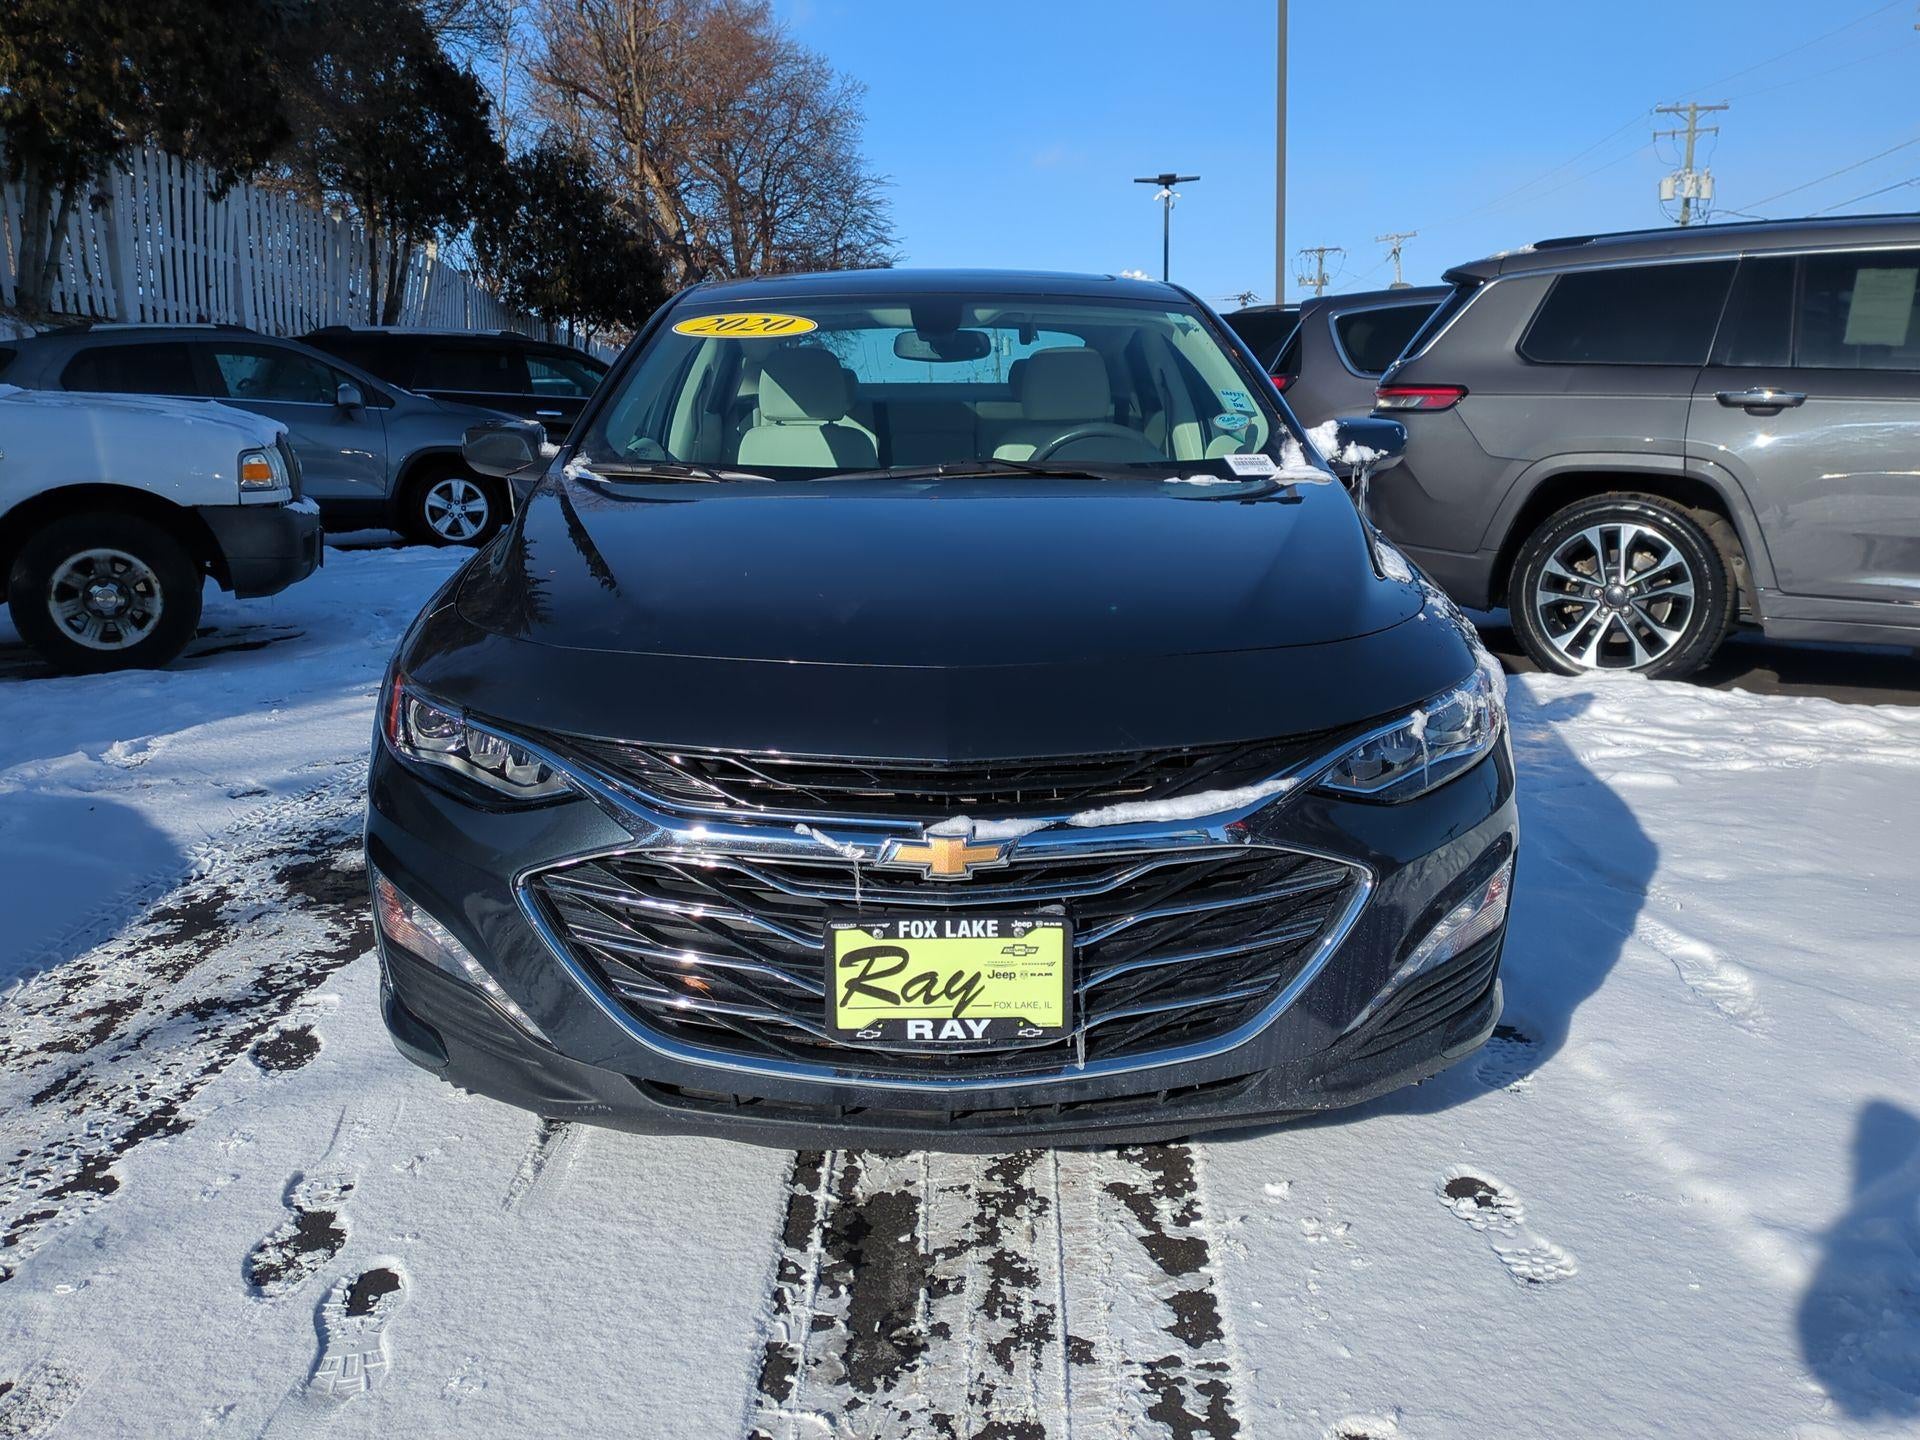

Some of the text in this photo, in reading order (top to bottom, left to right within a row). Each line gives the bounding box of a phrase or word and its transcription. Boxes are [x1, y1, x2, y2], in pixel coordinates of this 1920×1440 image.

[689, 318, 796, 331] 2020
[898, 920, 999, 939] FOX LAKE
[1011, 920, 1032, 928] Jeep
[839, 945, 986, 1018] Ray
[987, 969, 1016, 981] Jeep
[993, 1001, 1053, 1010] FOX LAKE, IL
[907, 1019, 992, 1040] RAY
